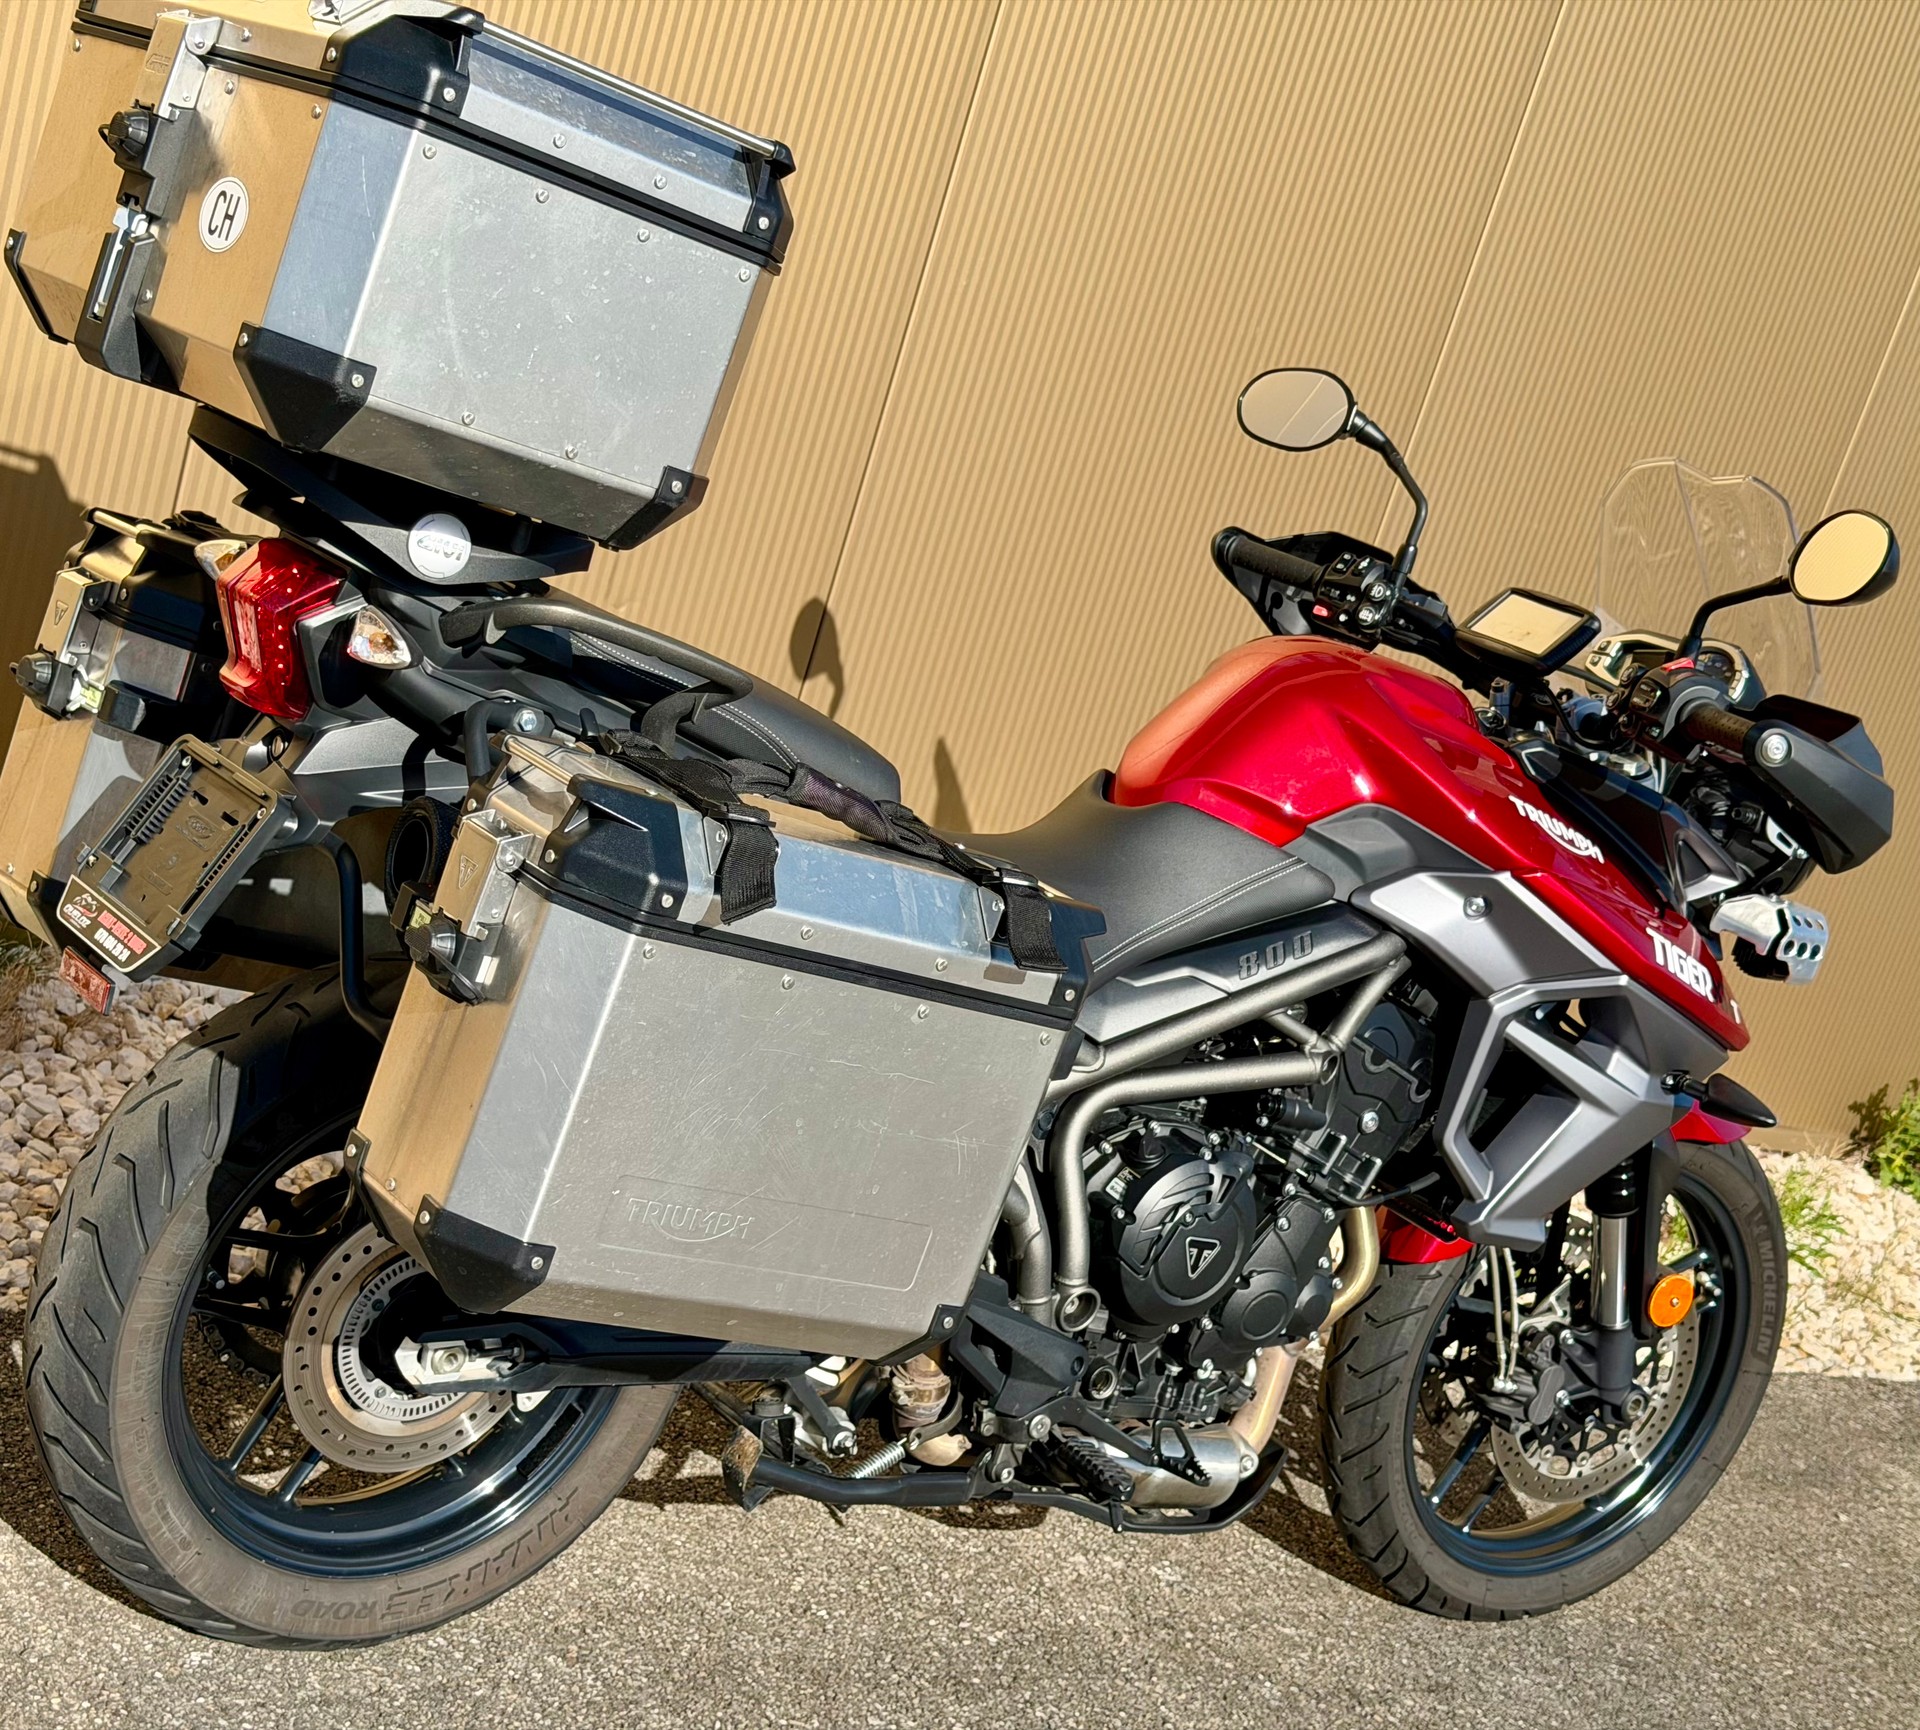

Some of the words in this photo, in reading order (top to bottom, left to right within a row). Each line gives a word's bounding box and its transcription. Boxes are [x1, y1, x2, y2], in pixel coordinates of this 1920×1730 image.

[207, 189, 241, 242] CH
[1508, 794, 1604, 864] TRIUMPH
[1238, 930, 1313, 981] 800
[1645, 926, 1715, 1003] TIGER
[627, 1197, 756, 1242] TRIUMPH
[1756, 1239, 1777, 1356] MICHELIN
[290, 1599, 378, 1620] ROAD
